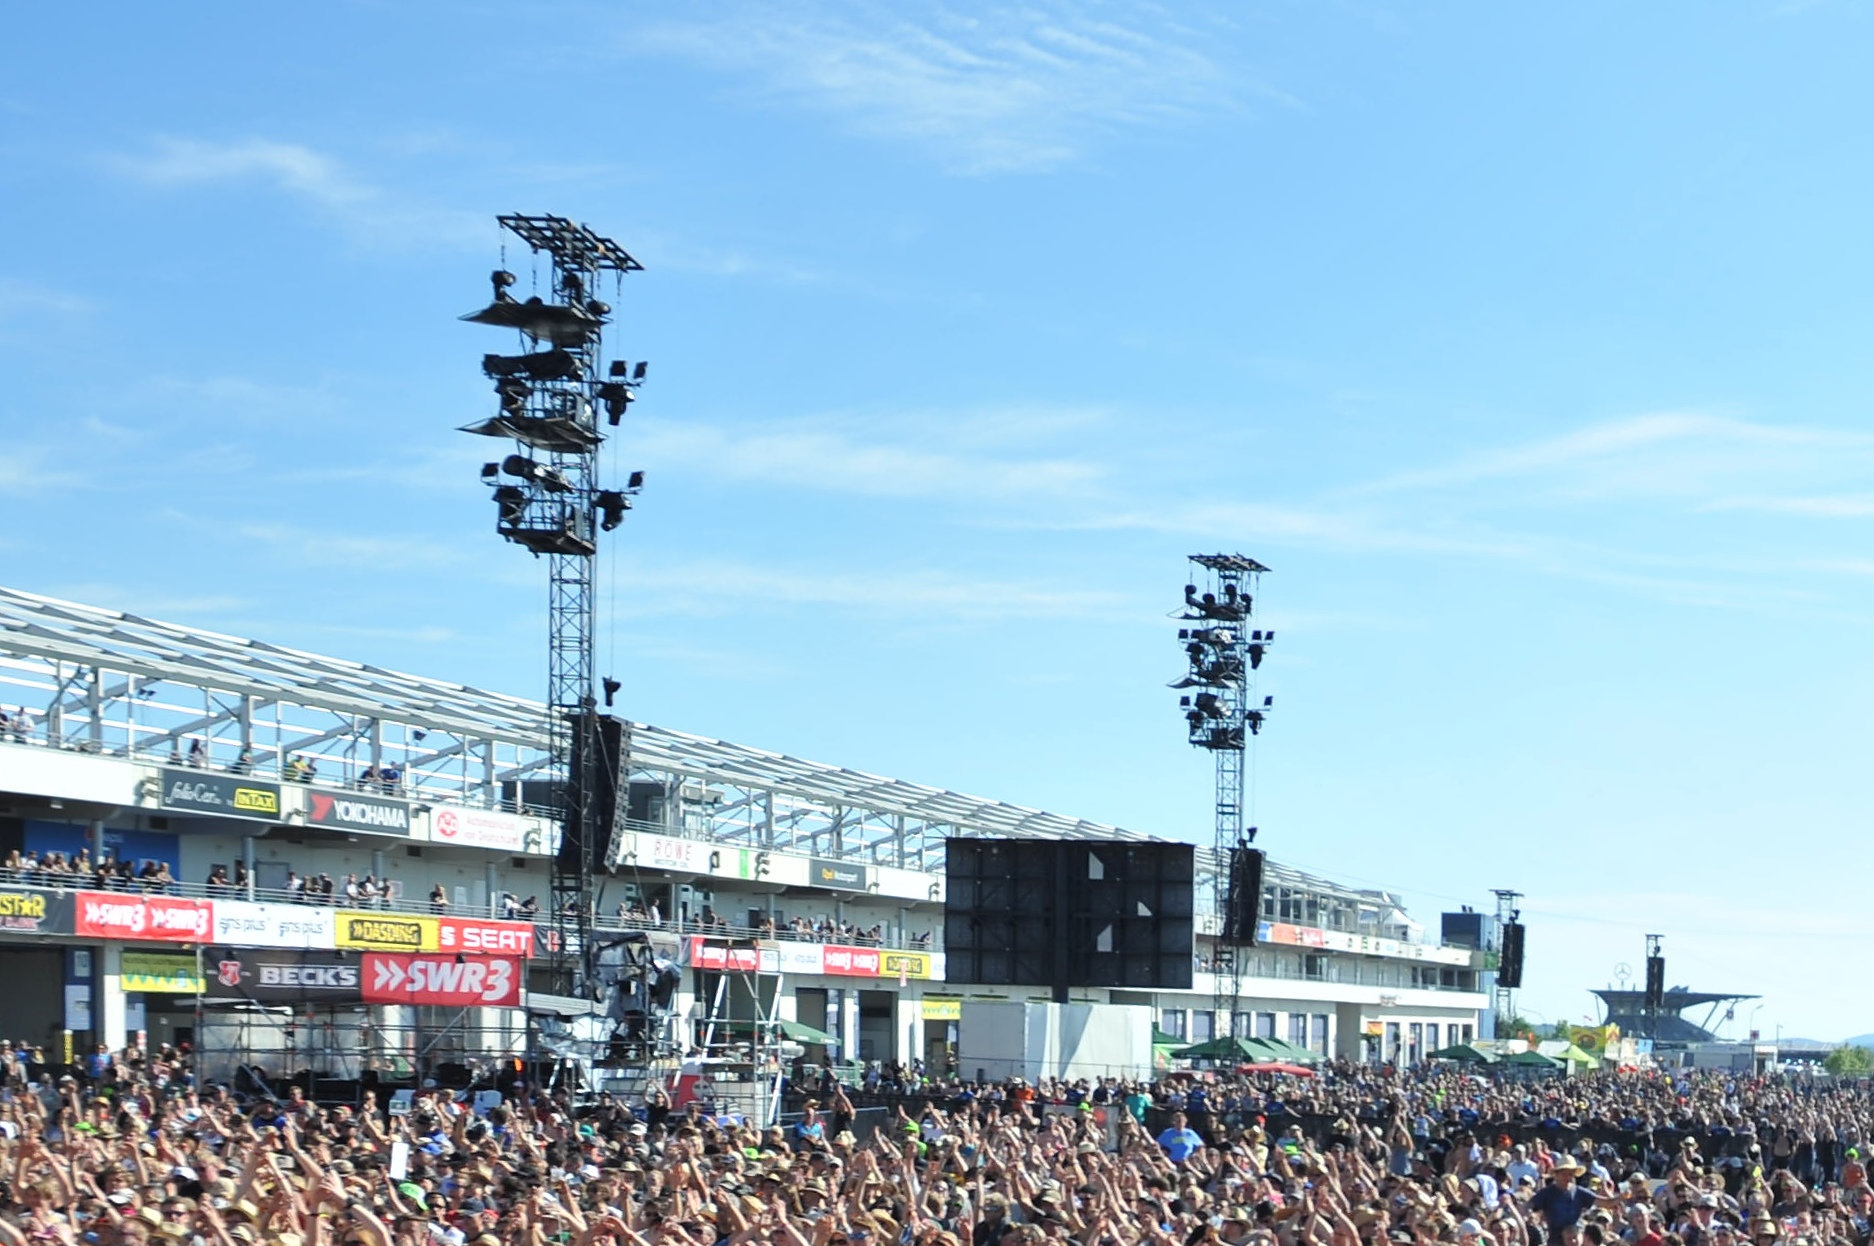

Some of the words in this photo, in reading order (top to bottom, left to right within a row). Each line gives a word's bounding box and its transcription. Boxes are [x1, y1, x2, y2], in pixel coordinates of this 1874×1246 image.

[334, 800, 407, 828] YOKOHAMA
[463, 928, 532, 950] SEAT
[259, 966, 358, 986] BECK'S
[406, 960, 512, 1001] SWR3
